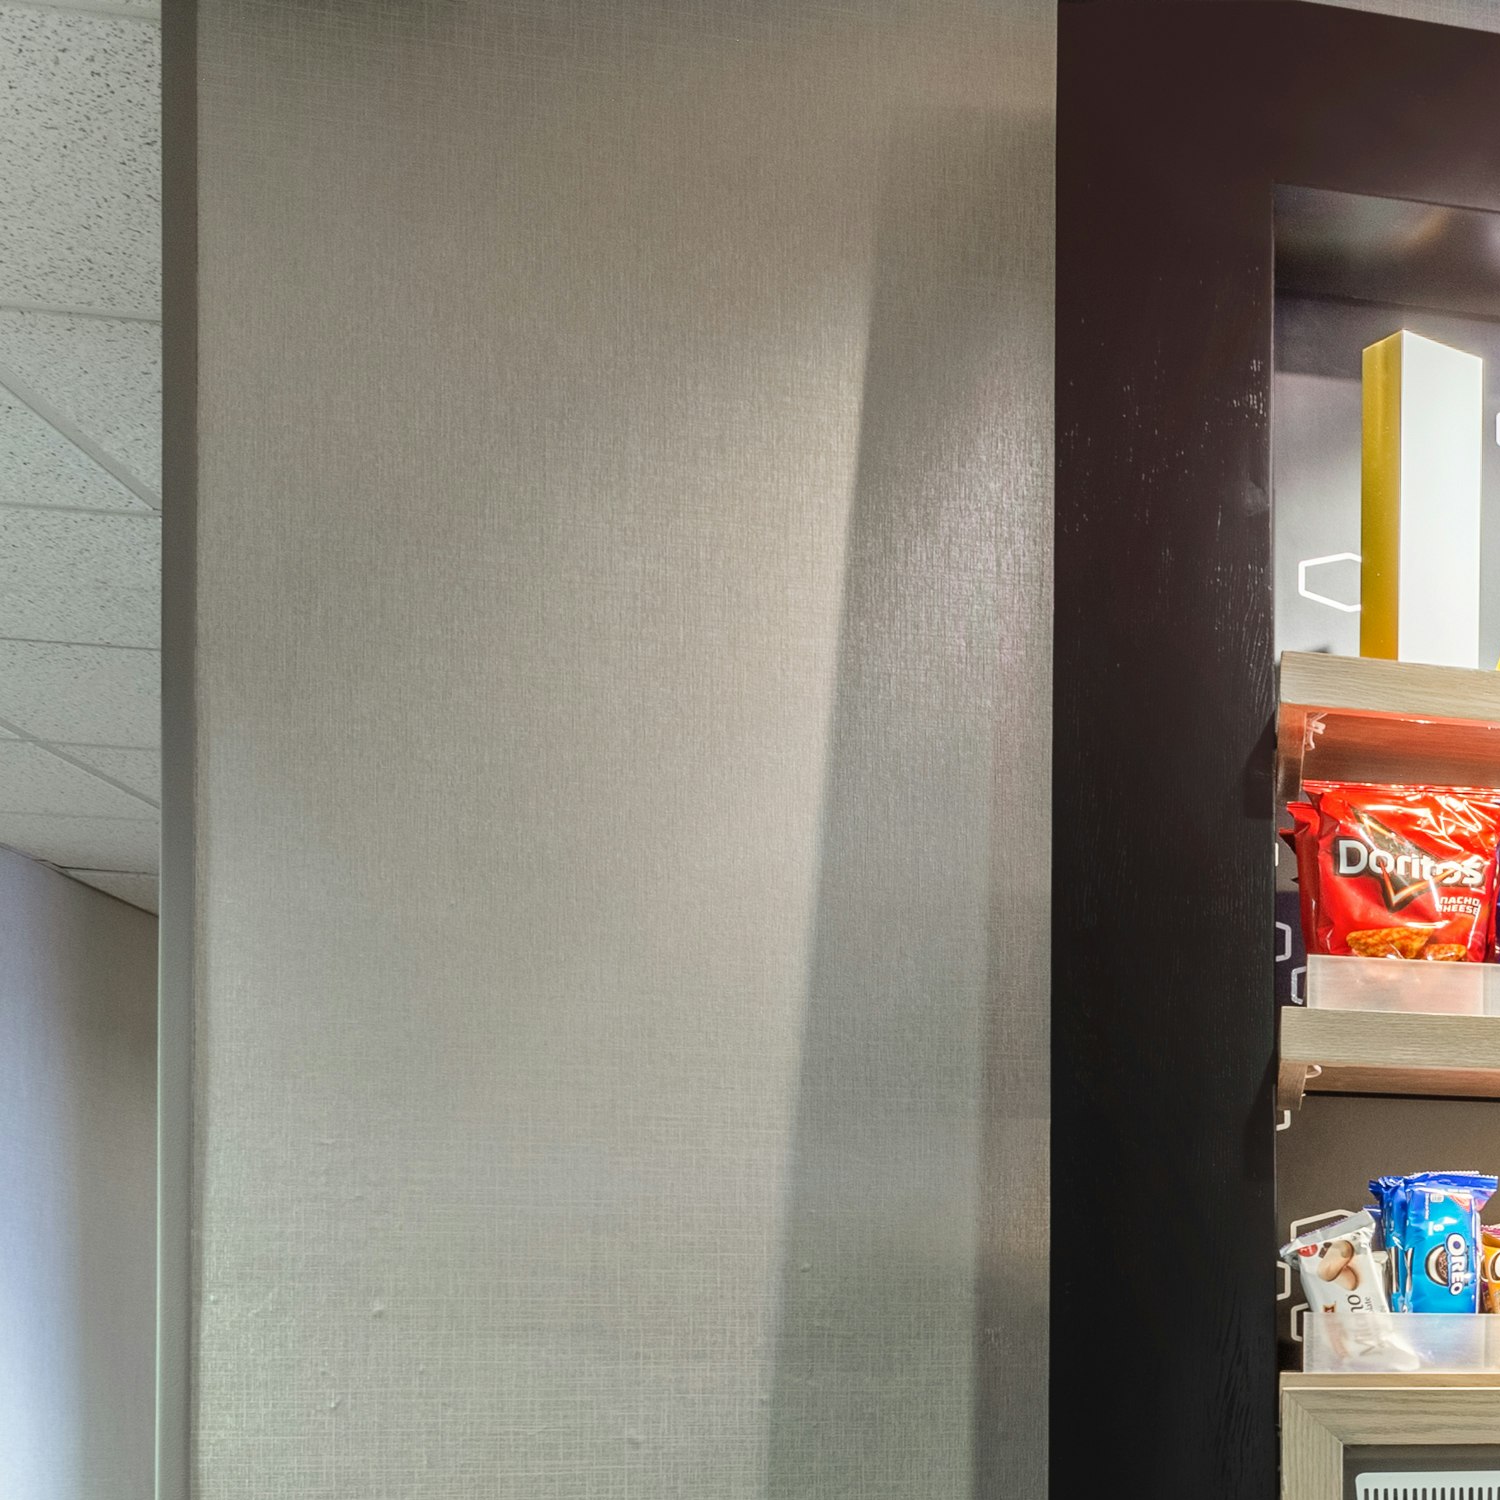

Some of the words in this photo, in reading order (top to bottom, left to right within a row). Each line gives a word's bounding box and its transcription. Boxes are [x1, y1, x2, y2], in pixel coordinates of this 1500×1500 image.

[1338, 839, 1484, 885] Doritos
[1440, 895, 1480, 906] NACHO
[1446, 1232, 1467, 1296] OREO
